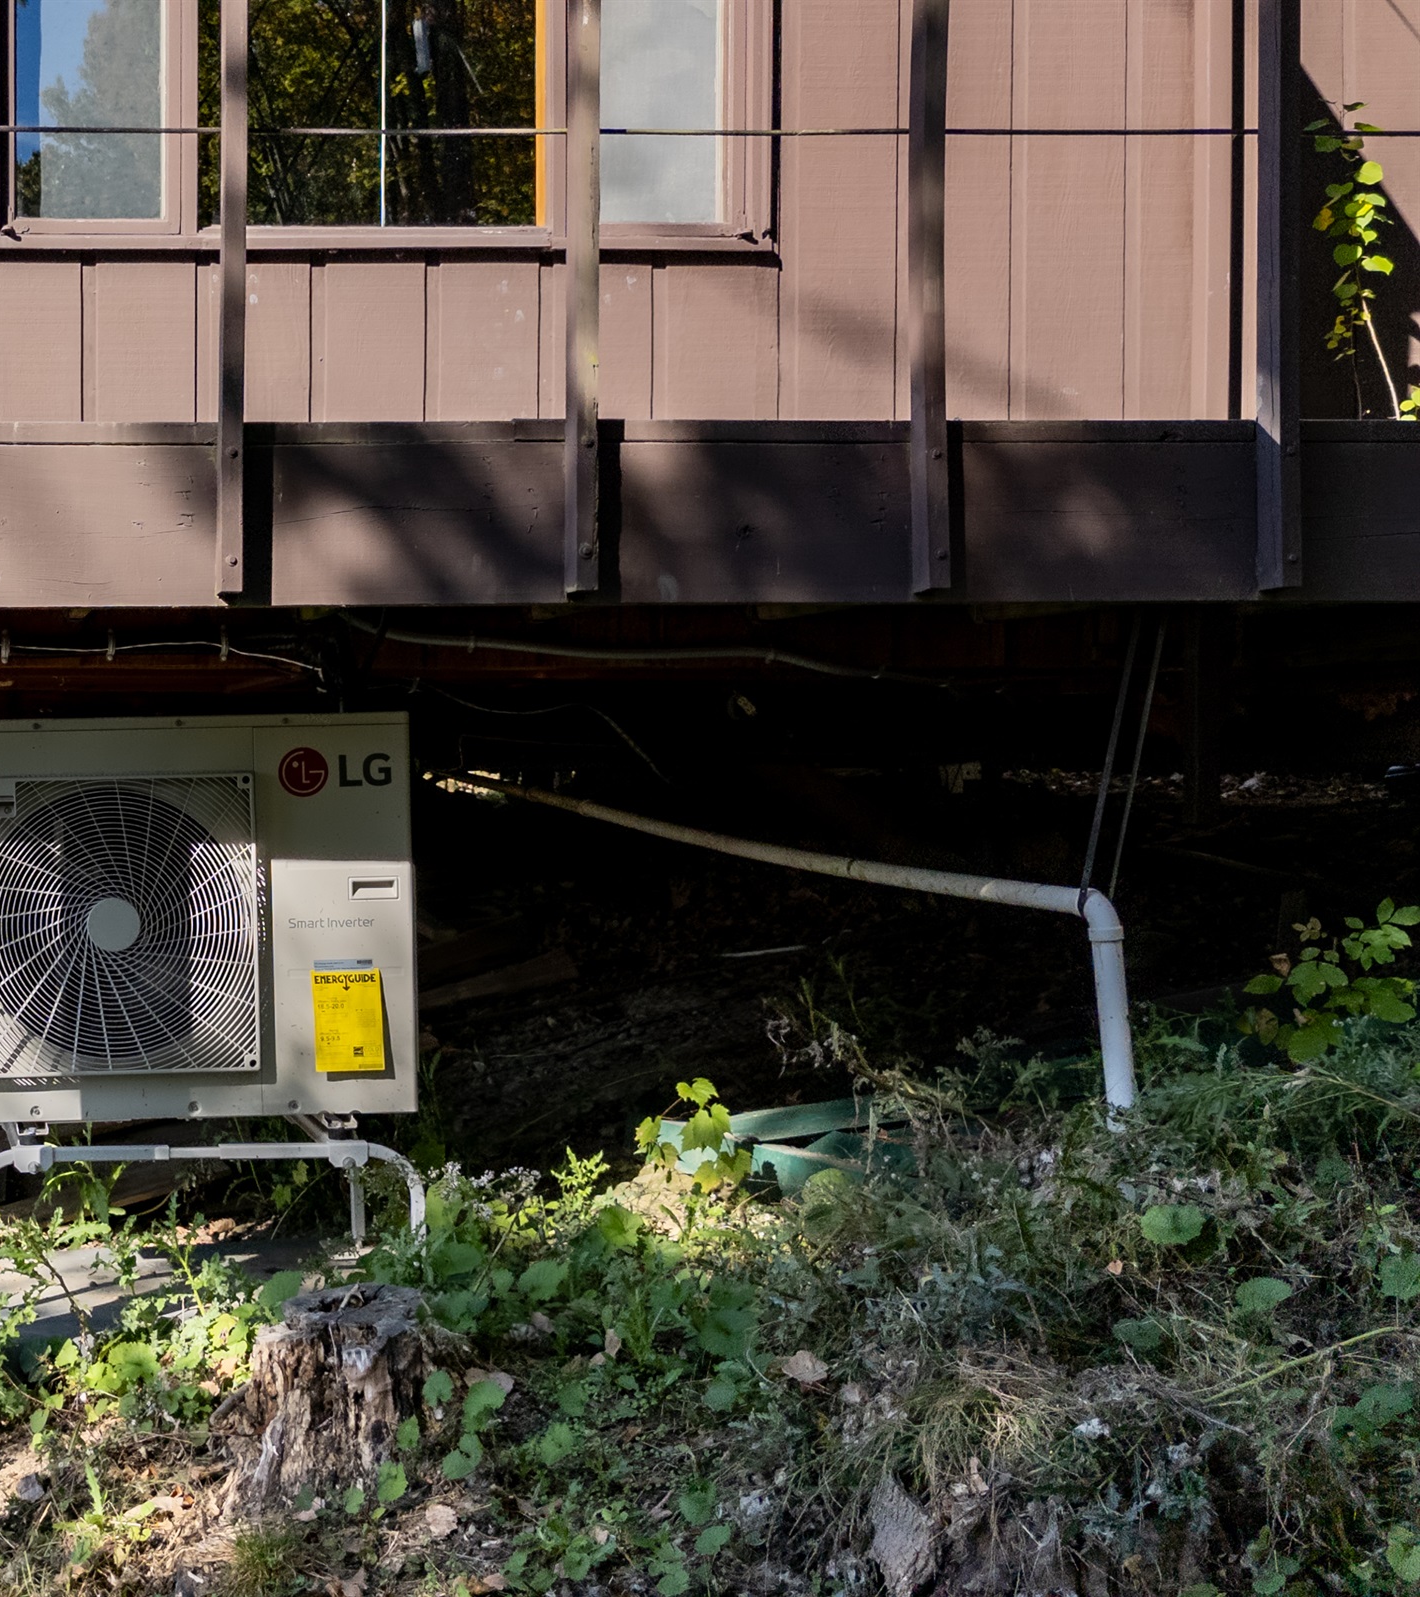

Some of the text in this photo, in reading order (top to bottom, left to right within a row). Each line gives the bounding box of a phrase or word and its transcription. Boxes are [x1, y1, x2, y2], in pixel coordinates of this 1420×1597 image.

[338, 752, 393, 788] LG
[288, 917, 375, 929] Smart Inverter
